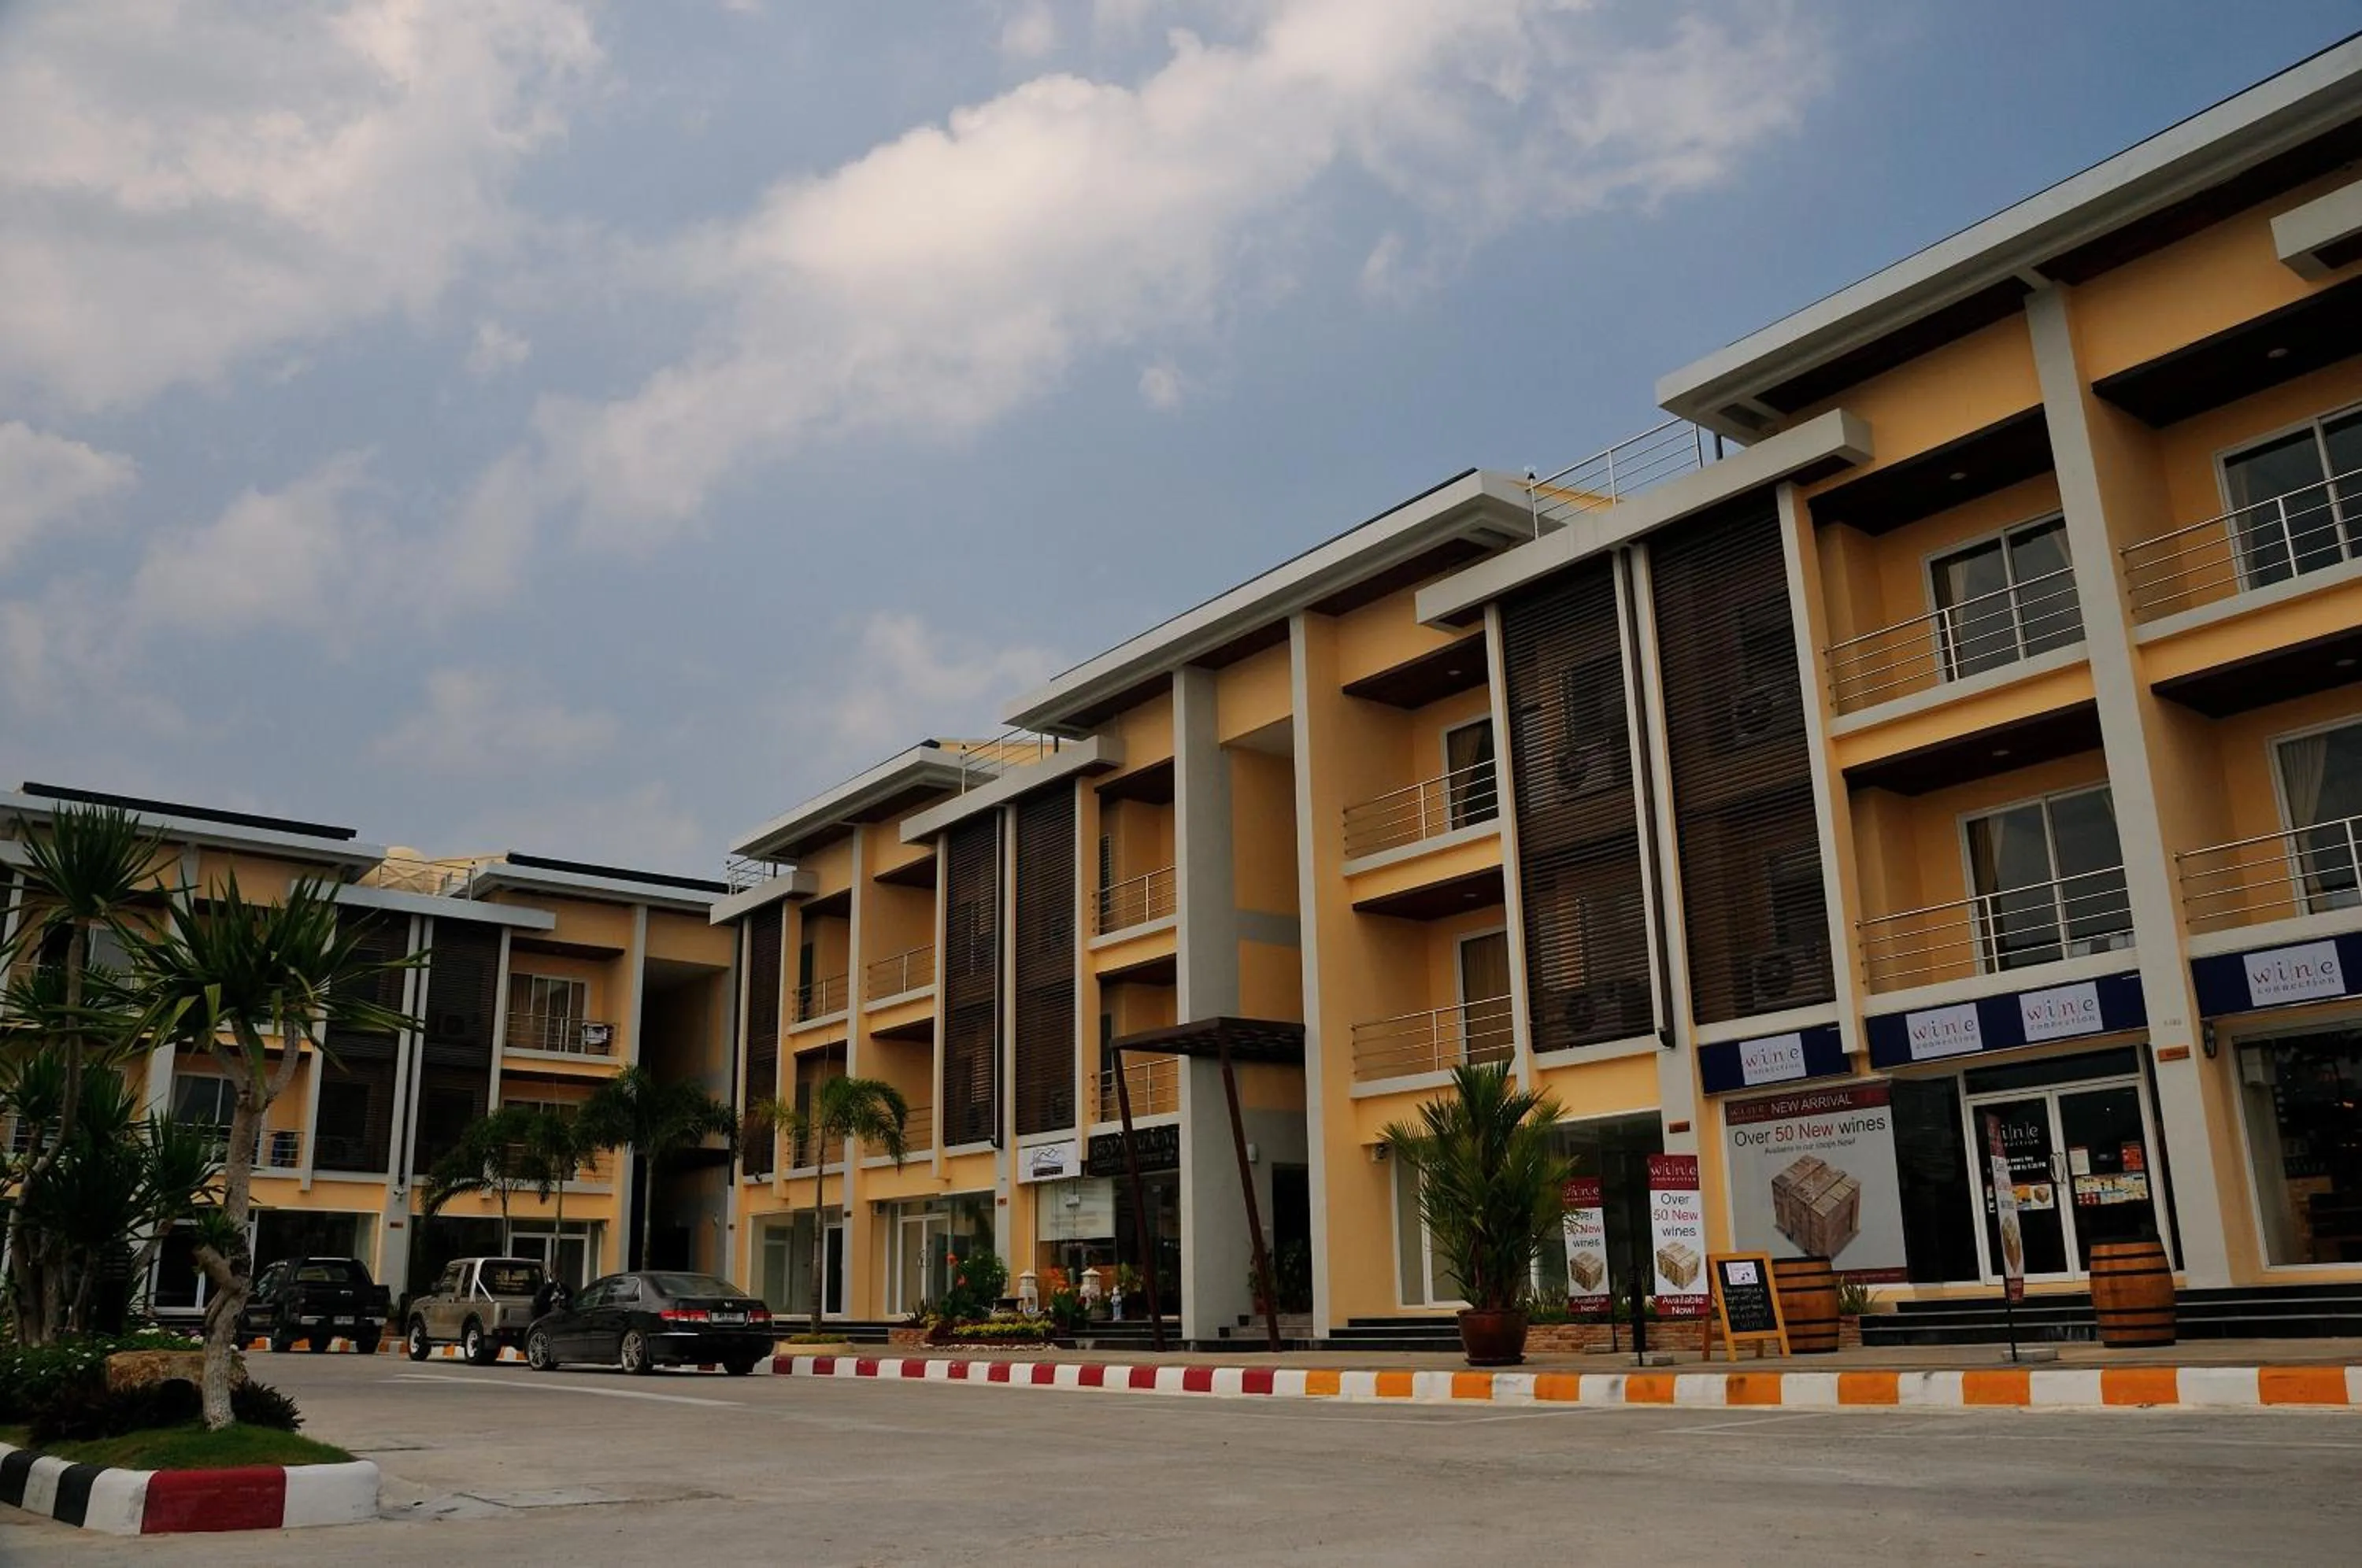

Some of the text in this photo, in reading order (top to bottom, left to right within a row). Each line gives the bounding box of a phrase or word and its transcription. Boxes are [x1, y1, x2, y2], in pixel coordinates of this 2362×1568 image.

[2253, 959, 2334, 984] wine
[2027, 997, 2094, 1022] wine
[1912, 1018, 1975, 1041] wine
[1745, 1046, 1800, 1067] wine
[1770, 1091, 1853, 1115] NEW ARRIVAL
[1734, 1115, 1886, 1148] Over 50 New wines
[2001, 1121, 2038, 1141] ine
[1651, 1162, 1697, 1176] wine
[1660, 1193, 1690, 1205] Over
[1653, 1208, 1698, 1221] 50 New
[1662, 1226, 1697, 1237] wines
[1662, 1295, 1704, 1304] Available
[1672, 1306, 1695, 1315] Now!
